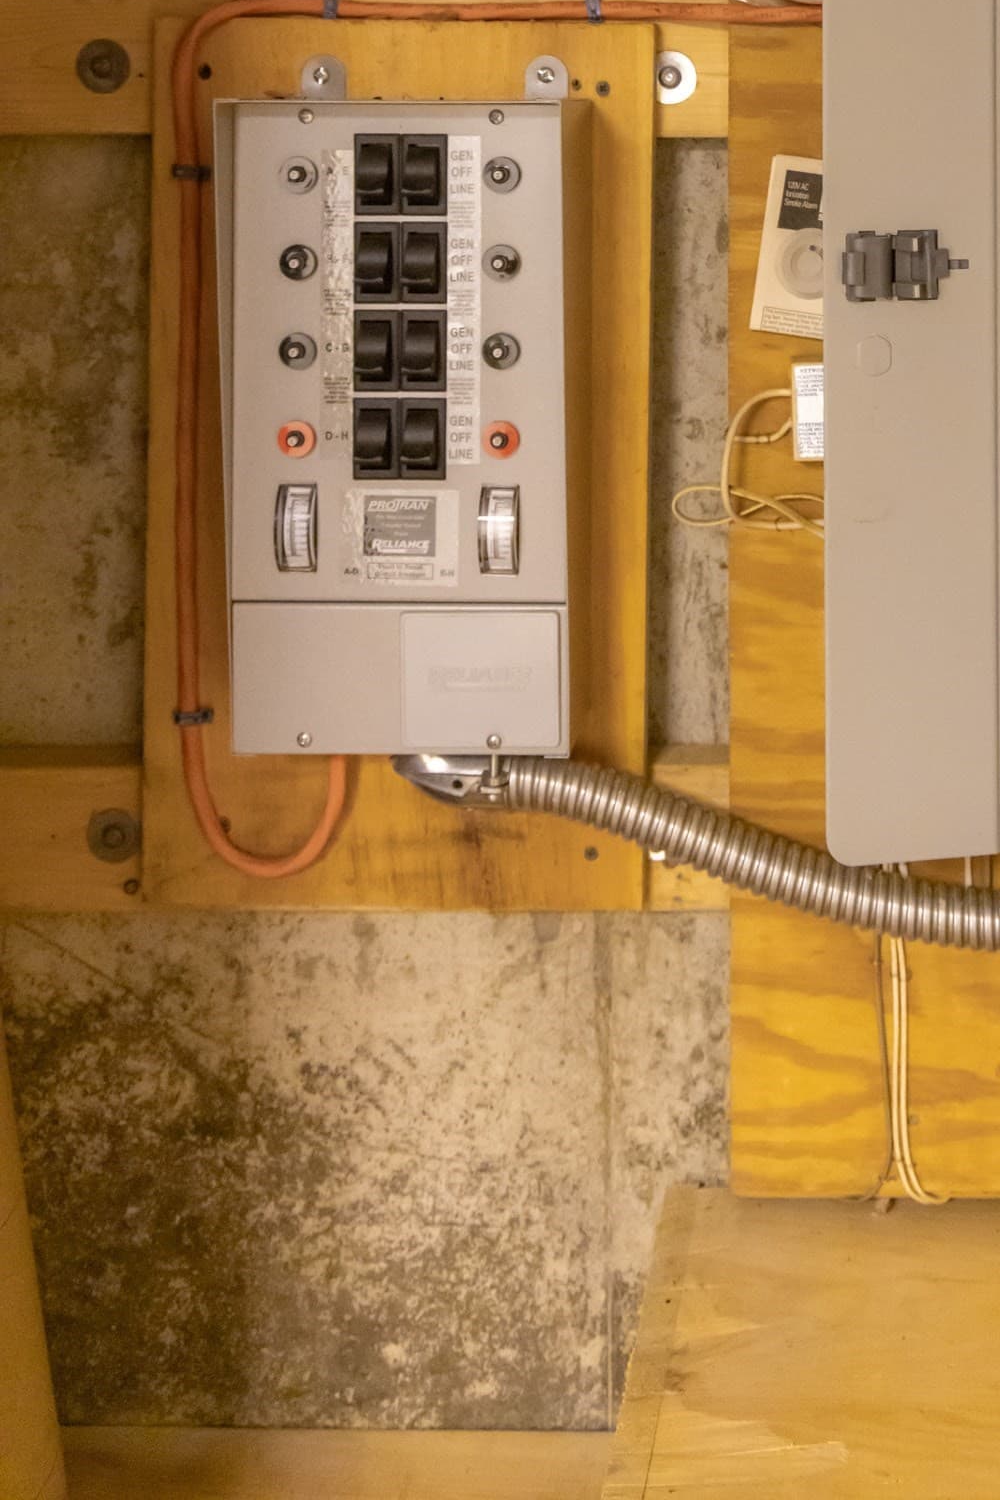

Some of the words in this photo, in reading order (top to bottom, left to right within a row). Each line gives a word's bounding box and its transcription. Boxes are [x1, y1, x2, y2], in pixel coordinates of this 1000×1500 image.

[450, 151, 474, 161] GEN
[450, 167, 473, 177] OFF
[449, 184, 475, 194] LINE
[450, 239, 474, 249] GEN
[450, 255, 473, 265] OFF
[449, 272, 475, 282] LINE
[450, 328, 474, 338] GEN
[450, 344, 473, 354] OFF
[449, 361, 475, 371] LINE
[450, 416, 474, 426] GEN
[450, 432, 473, 442] OFF
[449, 449, 475, 460] LINE
[371, 538, 430, 554] RELIANCE
